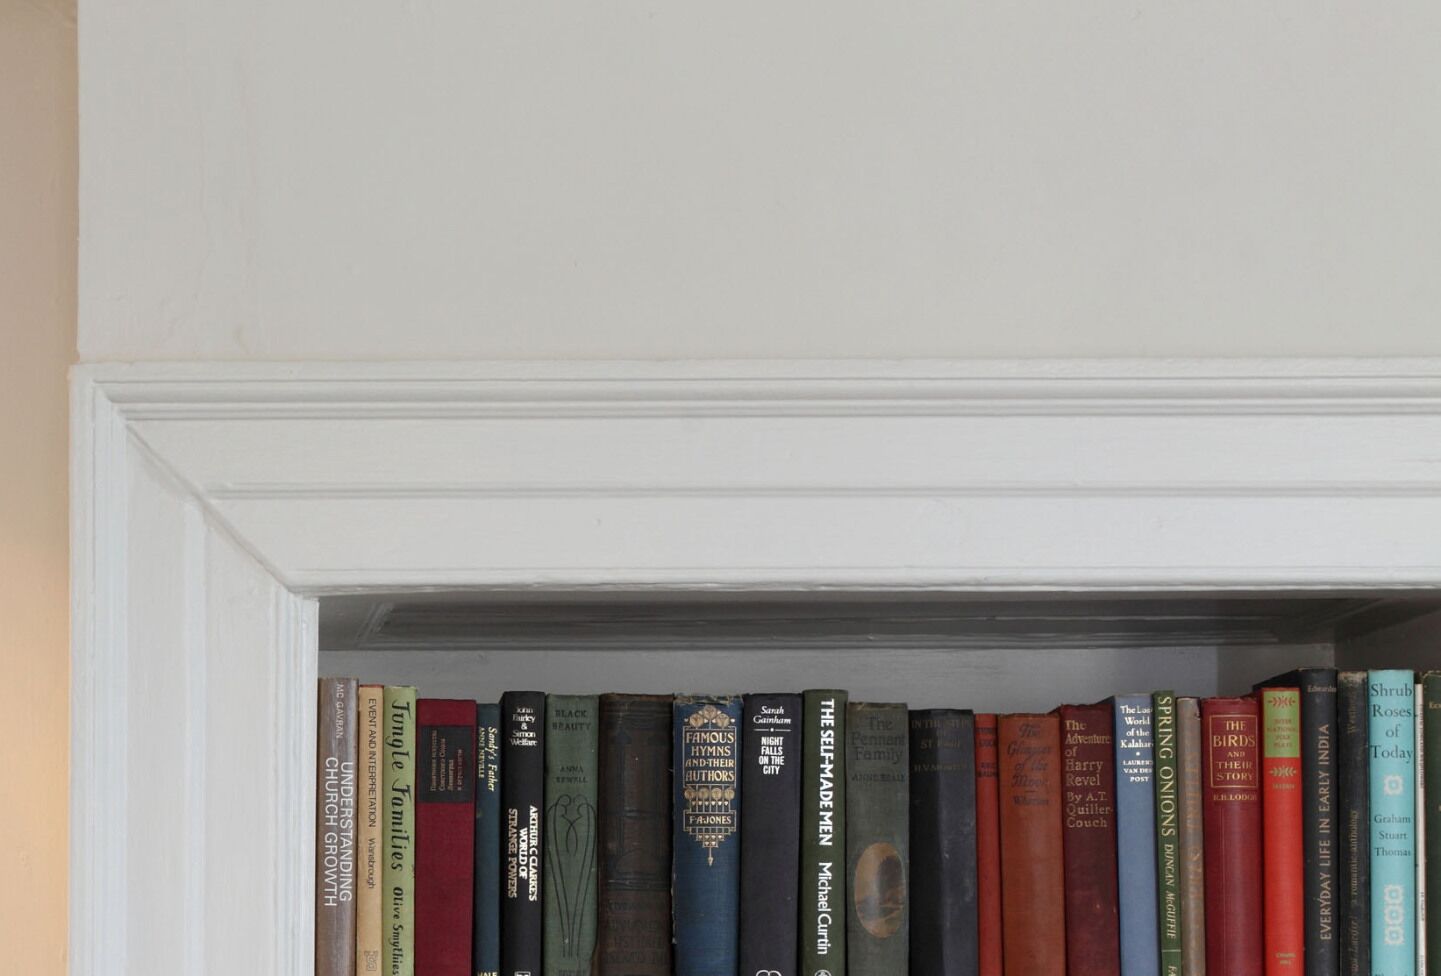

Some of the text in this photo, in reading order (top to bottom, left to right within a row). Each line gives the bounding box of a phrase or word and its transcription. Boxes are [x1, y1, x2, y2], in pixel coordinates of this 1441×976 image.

[1371, 684, 1412, 697] Shrub
[554, 710, 588, 718] BLACK
[761, 706, 784, 715] Sarah
[1120, 706, 1135, 714] The
[1373, 704, 1411, 718] Roses
[753, 716, 791, 724] Gainham
[1065, 720, 1087, 731] The
[1124, 717, 1151, 725] World
[1225, 720, 1246, 731] THE
[551, 722, 591, 731] BEAUTY
[1126, 728, 1149, 736] of the
[1158, 696, 1173, 759] SPRING
[1385, 724, 1400, 738] of
[385, 701, 410, 770] Jungle
[685, 732, 735, 744] FAMOUS
[761, 737, 784, 746] NIGHT
[1213, 735, 1256, 747] BIRDS
[691, 746, 731, 756] HYMNS
[761, 746, 783, 755] FALLS
[1065, 747, 1077, 757] of
[1371, 745, 1414, 764] Today
[485, 727, 498, 791] Sandy's Father
[759, 756, 784, 765] ON THE
[1216, 761, 1252, 769] THEIR
[763, 766, 780, 775] CITY
[819, 698, 834, 846] THE SELF-MADE MEN
[1065, 760, 1103, 773] Harry
[685, 770, 735, 782] AUTHORS
[1066, 774, 1101, 786] Revel
[1216, 772, 1253, 781] STORY
[367, 698, 376, 889] EVENT AND INTERPRETATION Wansbrough
[1159, 766, 1176, 837] ONIONS
[391, 778, 410, 870] Families
[1067, 817, 1107, 828] Couch
[1374, 814, 1410, 825] Graham
[324, 757, 338, 906] CHURCH GROWTH
[339, 761, 353, 902] UNDERSTANDING
[529, 805, 539, 855] ARTHUR C
[1318, 724, 1332, 940] EVERYDAY LIFE IN EARLY INDIA
[1378, 831, 1408, 840] Stuart
[508, 808, 518, 898] STRANGE POWERS
[519, 827, 527, 880] WORLD OF
[1374, 847, 1411, 857] Thomas
[1164, 843, 1174, 886] DUNCAN
[392, 887, 404, 919] Olive
[817, 862, 832, 955] Michael Curtin
[389, 924, 404, 976] Smythies
